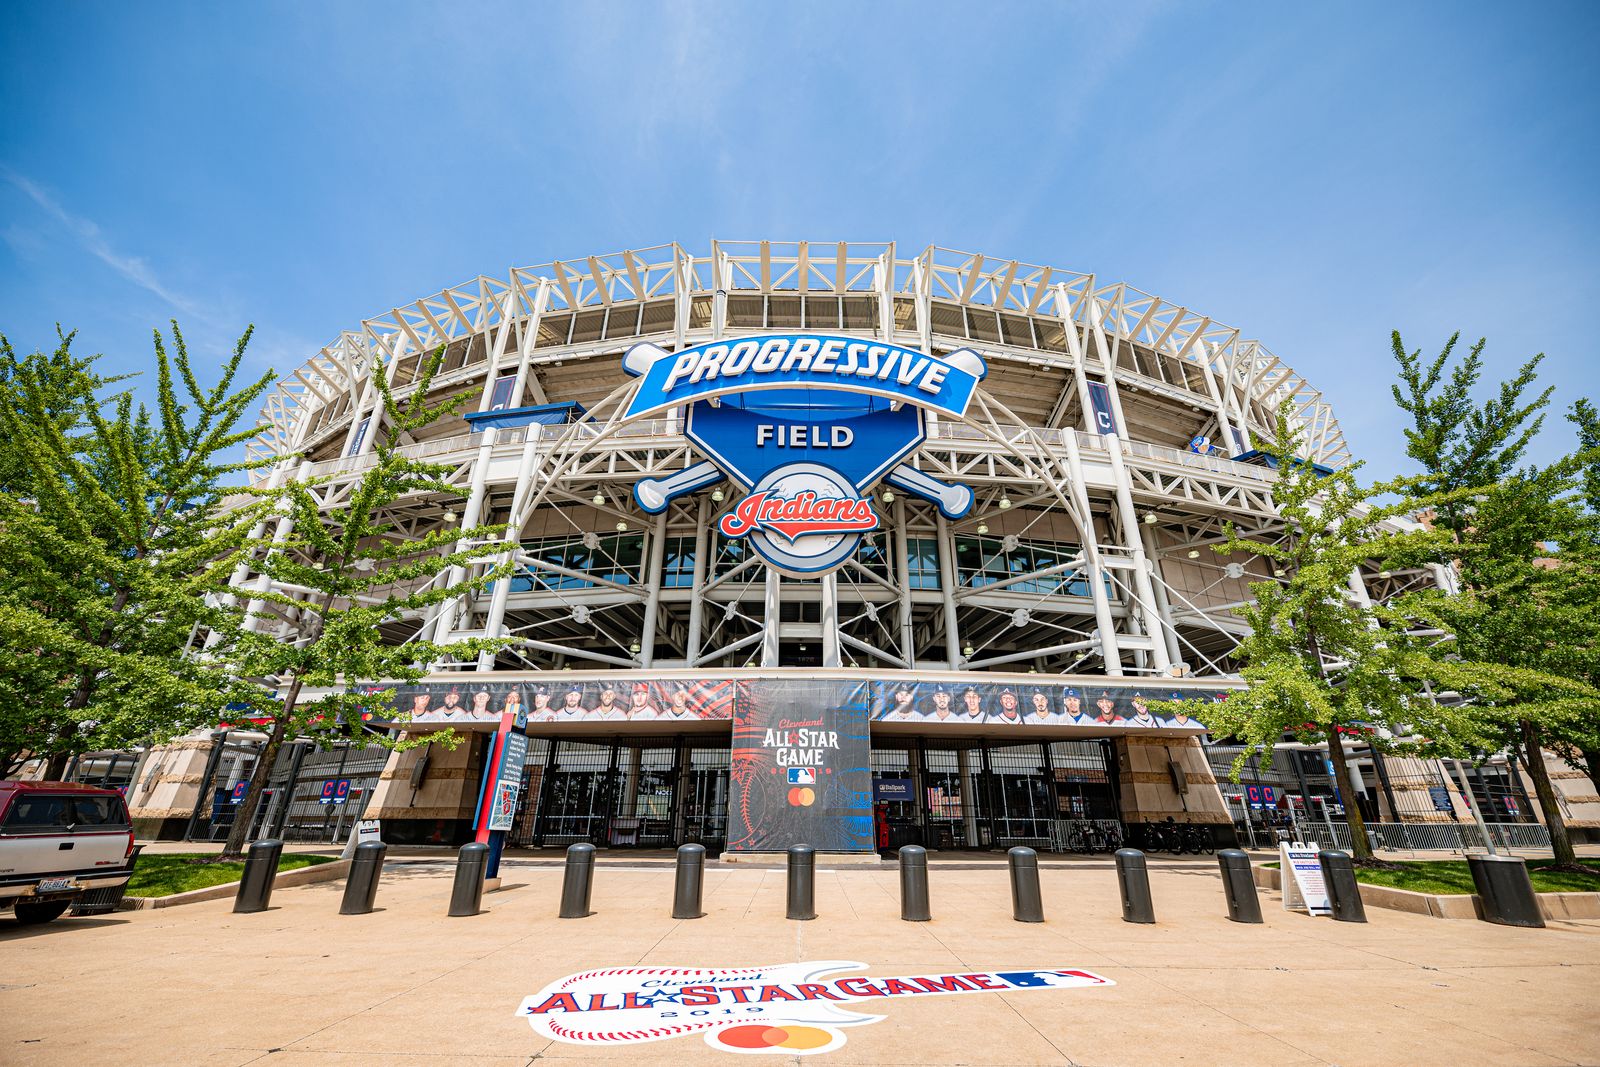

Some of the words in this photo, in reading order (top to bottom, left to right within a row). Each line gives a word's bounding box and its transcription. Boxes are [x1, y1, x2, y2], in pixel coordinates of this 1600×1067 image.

[661, 338, 951, 394] PROGRESSIVE
[1097, 411, 1111, 428] C
[756, 424, 855, 447] FIELD
[719, 489, 880, 539] Indians
[778, 717, 824, 729] Cleveland
[763, 728, 792, 747] ALL
[798, 728, 840, 749] STAR
[776, 748, 823, 767] GAME
[323, 782, 333, 796] C
[337, 782, 347, 796] C
[1249, 787, 1259, 801] C
[1263, 787, 1273, 801] C
[641, 973, 768, 988] Cleveland
[526, 991, 654, 1014] ALL
[834, 977, 1010, 997] GAME
[660, 1007, 764, 1018] 2019
